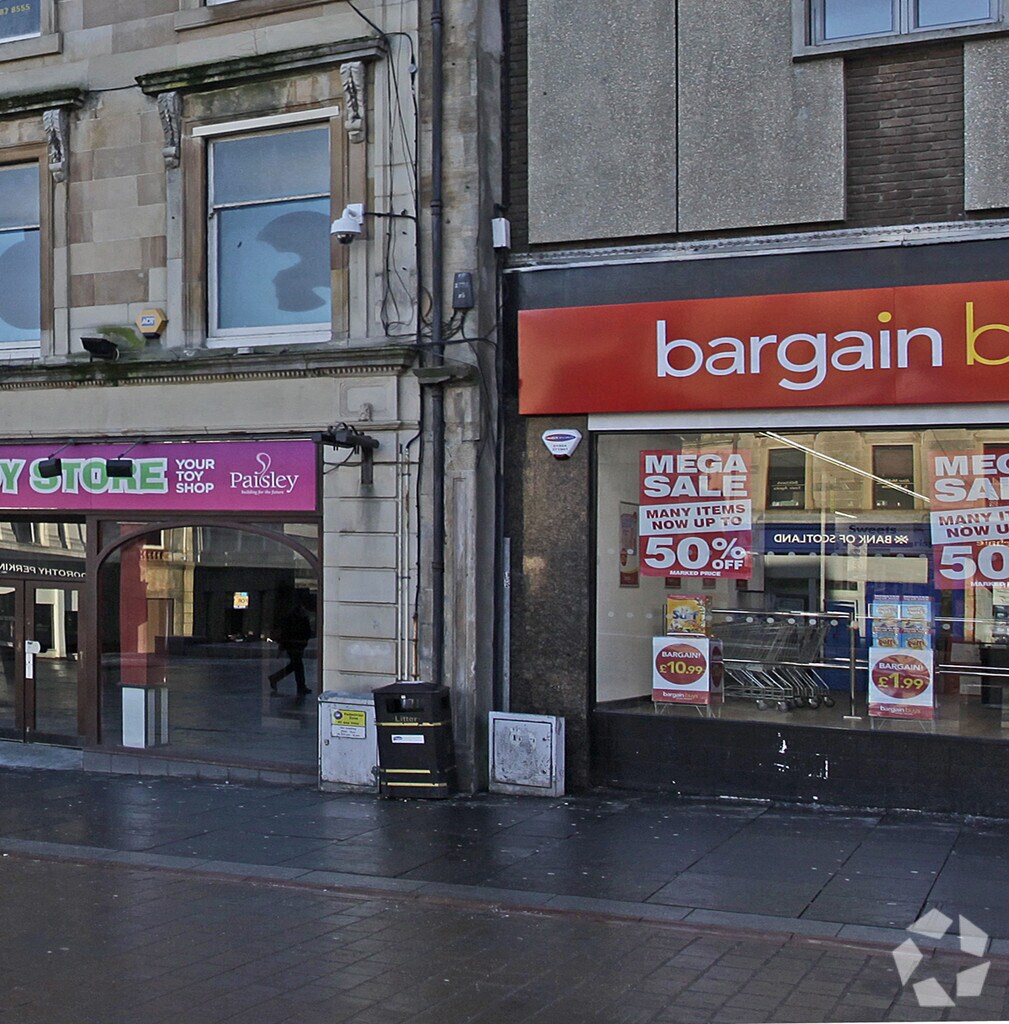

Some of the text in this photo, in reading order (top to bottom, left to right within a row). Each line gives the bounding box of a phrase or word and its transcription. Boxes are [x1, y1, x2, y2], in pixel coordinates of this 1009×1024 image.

[656, 311, 943, 390] bargain
[175, 459, 215, 470] YOUR
[645, 453, 748, 474] MEGA
[29, 457, 169, 494] STORE
[176, 471, 204, 482] TOY
[230, 464, 300, 493] Paisley
[176, 482, 215, 494] SHOP
[644, 475, 748, 497] SALE
[646, 504, 746, 519] MANY ITEMS
[652, 516, 742, 530] NOW UP TO
[938, 512, 992, 525] MANY
[848, 525, 897, 534] Sweets
[946, 525, 989, 538] NOW
[644, 537, 747, 569] 50%
[712, 560, 744, 570] OFF
[673, 610, 698, 620] Surf
[661, 651, 701, 659] BARGAIN!
[659, 661, 703, 675] £10.99
[879, 662, 923, 671] BARGAIN!
[878, 672, 924, 690] £1.99
